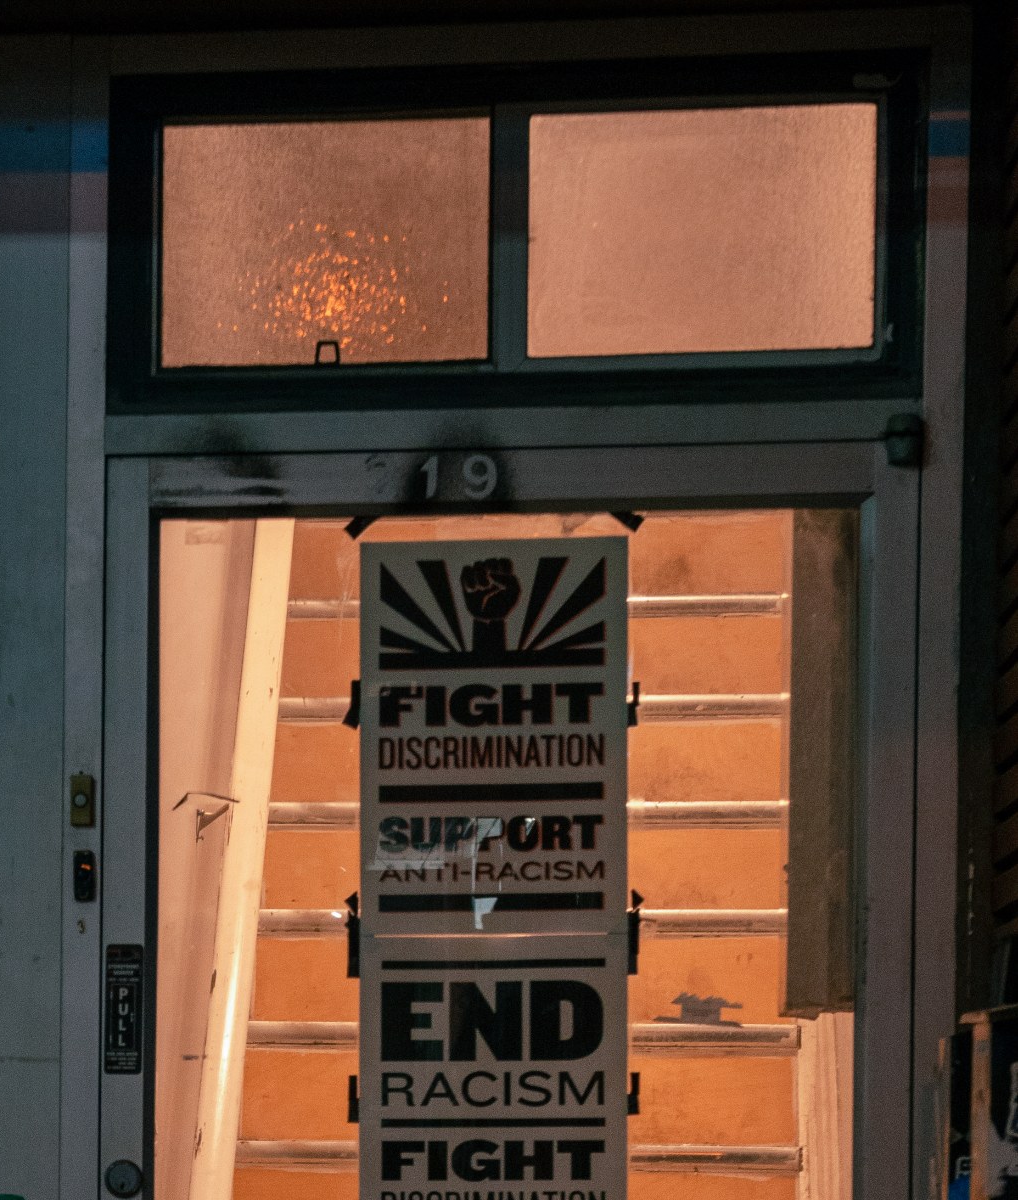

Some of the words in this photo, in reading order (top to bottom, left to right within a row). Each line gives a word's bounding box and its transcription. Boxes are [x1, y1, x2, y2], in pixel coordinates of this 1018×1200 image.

[378, 682, 606, 728] FIGHT
[378, 733, 606, 770] DISCRIMINATION
[378, 814, 605, 853] SUPPORT
[378, 860, 606, 884] ANTI-RACISM
[118, 988, 129, 1047] PULL
[382, 980, 605, 1062] END
[383, 1071, 606, 1108] RACISM
[382, 1138, 606, 1182] FIGHT
